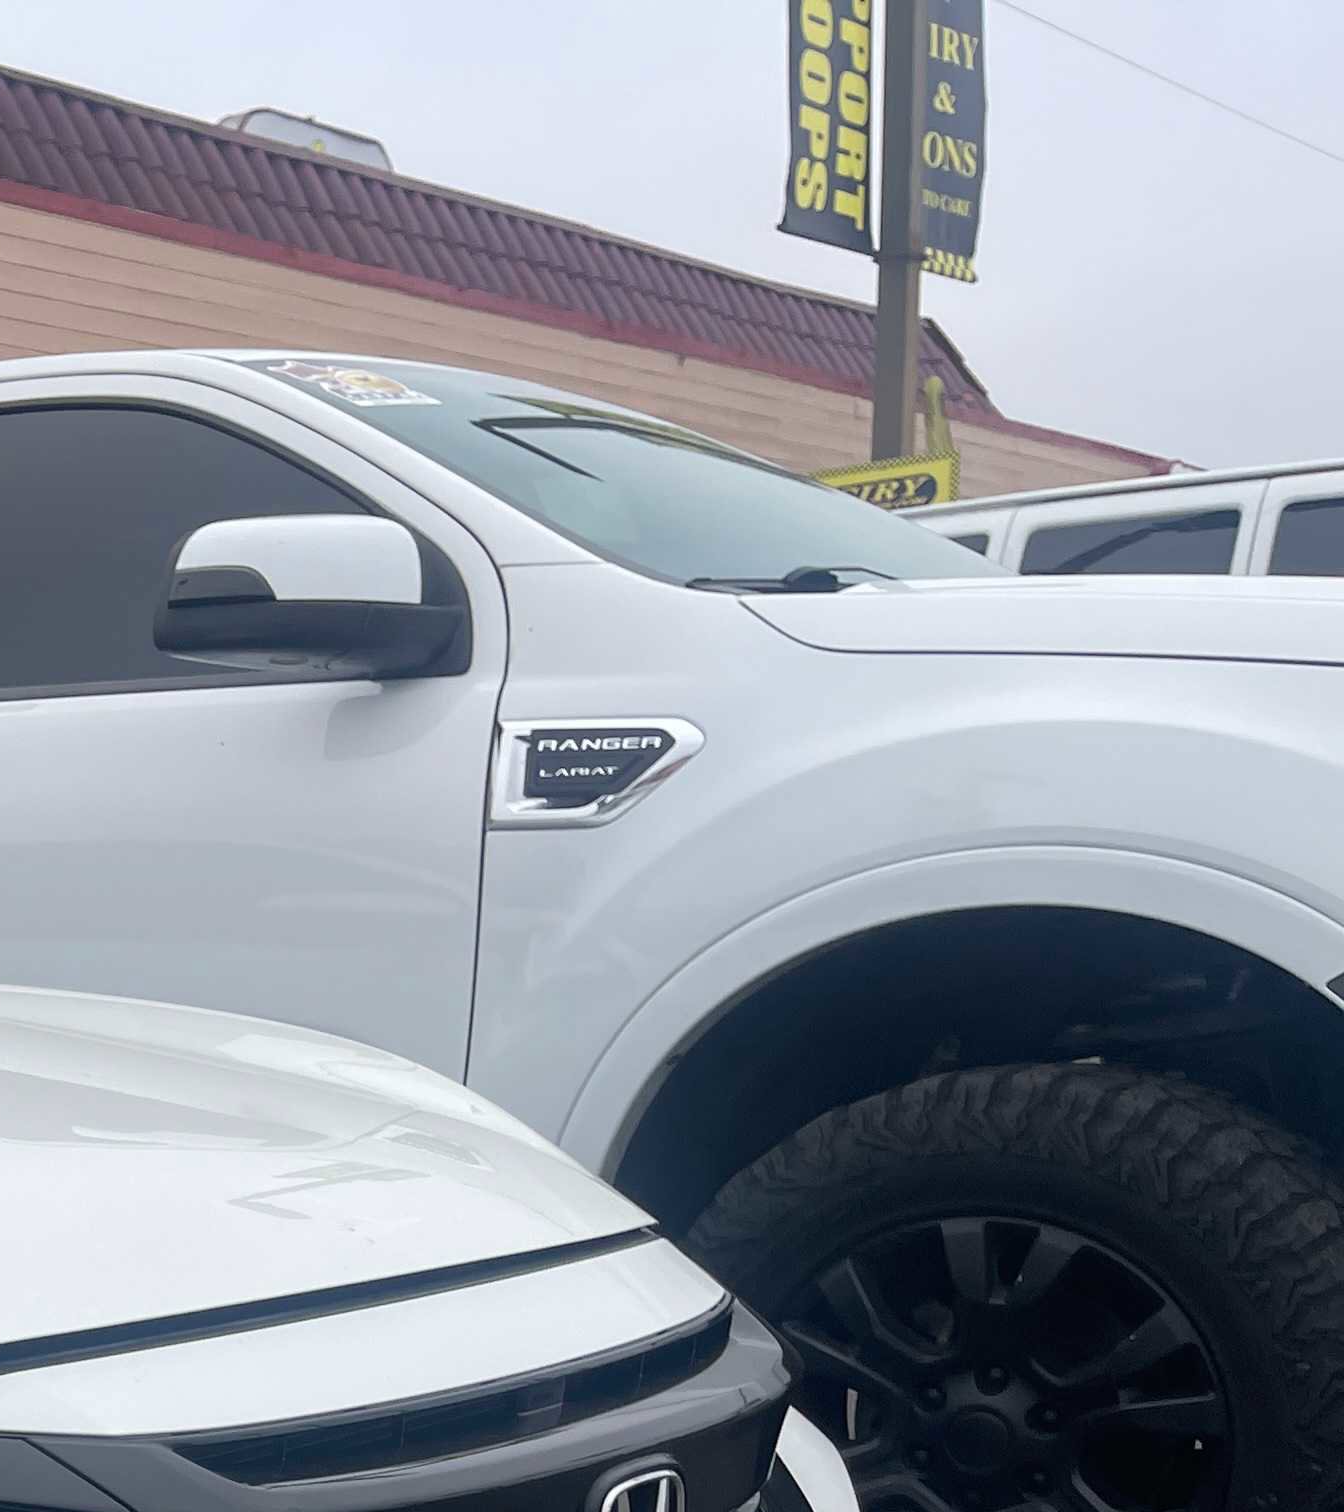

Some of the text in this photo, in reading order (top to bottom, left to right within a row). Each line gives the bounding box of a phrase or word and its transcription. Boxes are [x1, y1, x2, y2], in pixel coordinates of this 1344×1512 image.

[928, 22, 979, 70] IRY
[933, 81, 956, 114] &
[921, 131, 977, 178] ONS
[537, 735, 662, 752] RANGER
[539, 766, 620, 778] LARIAT
